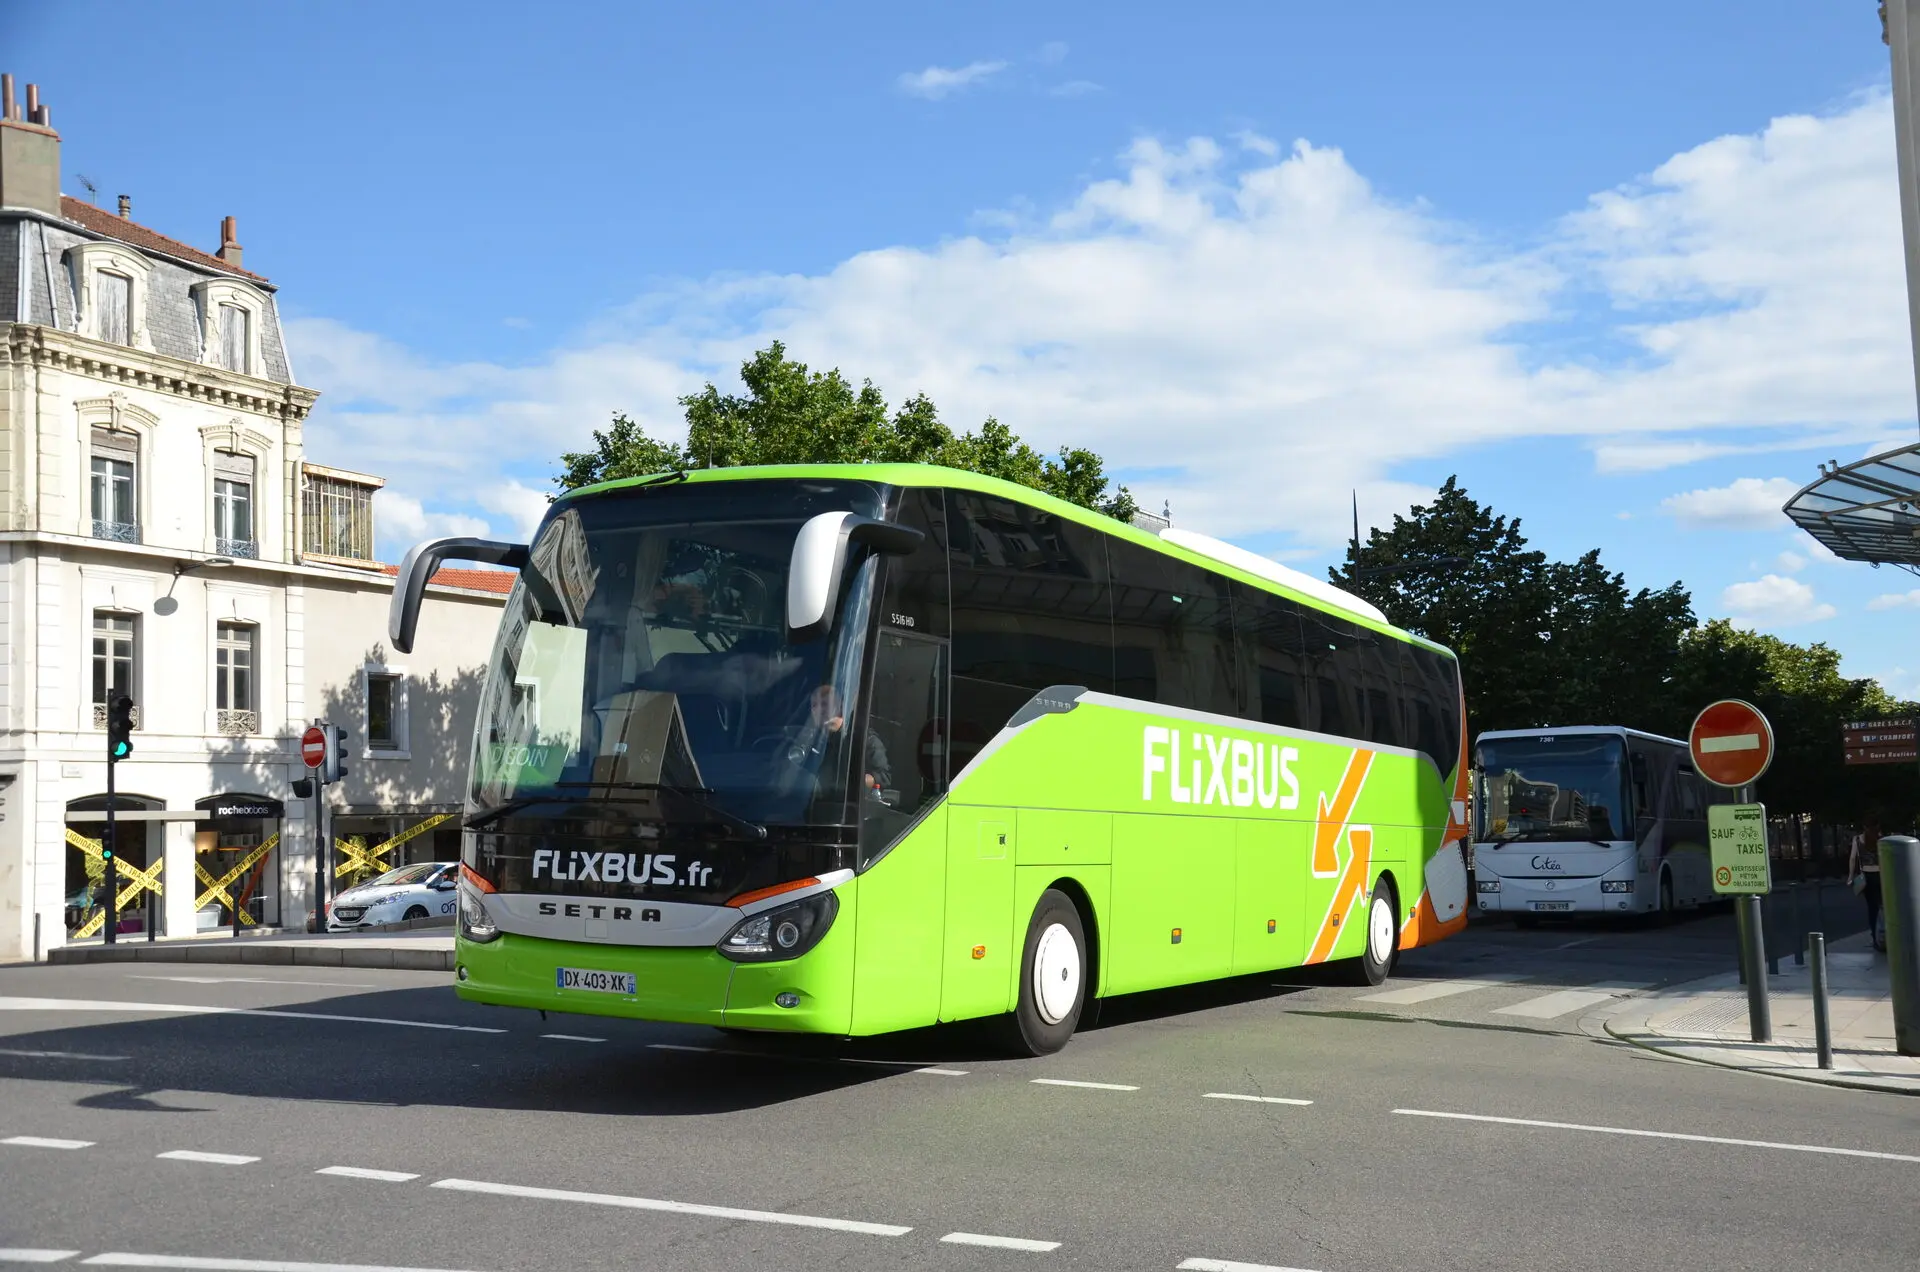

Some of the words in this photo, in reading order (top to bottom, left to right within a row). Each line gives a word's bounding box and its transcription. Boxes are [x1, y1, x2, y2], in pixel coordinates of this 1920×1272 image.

[1036, 698, 1071, 710] SETRA
[1711, 828, 1735, 839] SAUF
[65, 829, 102, 857] LIQUIDATIO
[1736, 844, 1764, 855] TAXIS
[247, 840, 272, 863] TRAVAUX
[1531, 855, 1561, 871] Citéa
[1719, 872, 1728, 881] 30
[538, 902, 662, 922] SETRA
